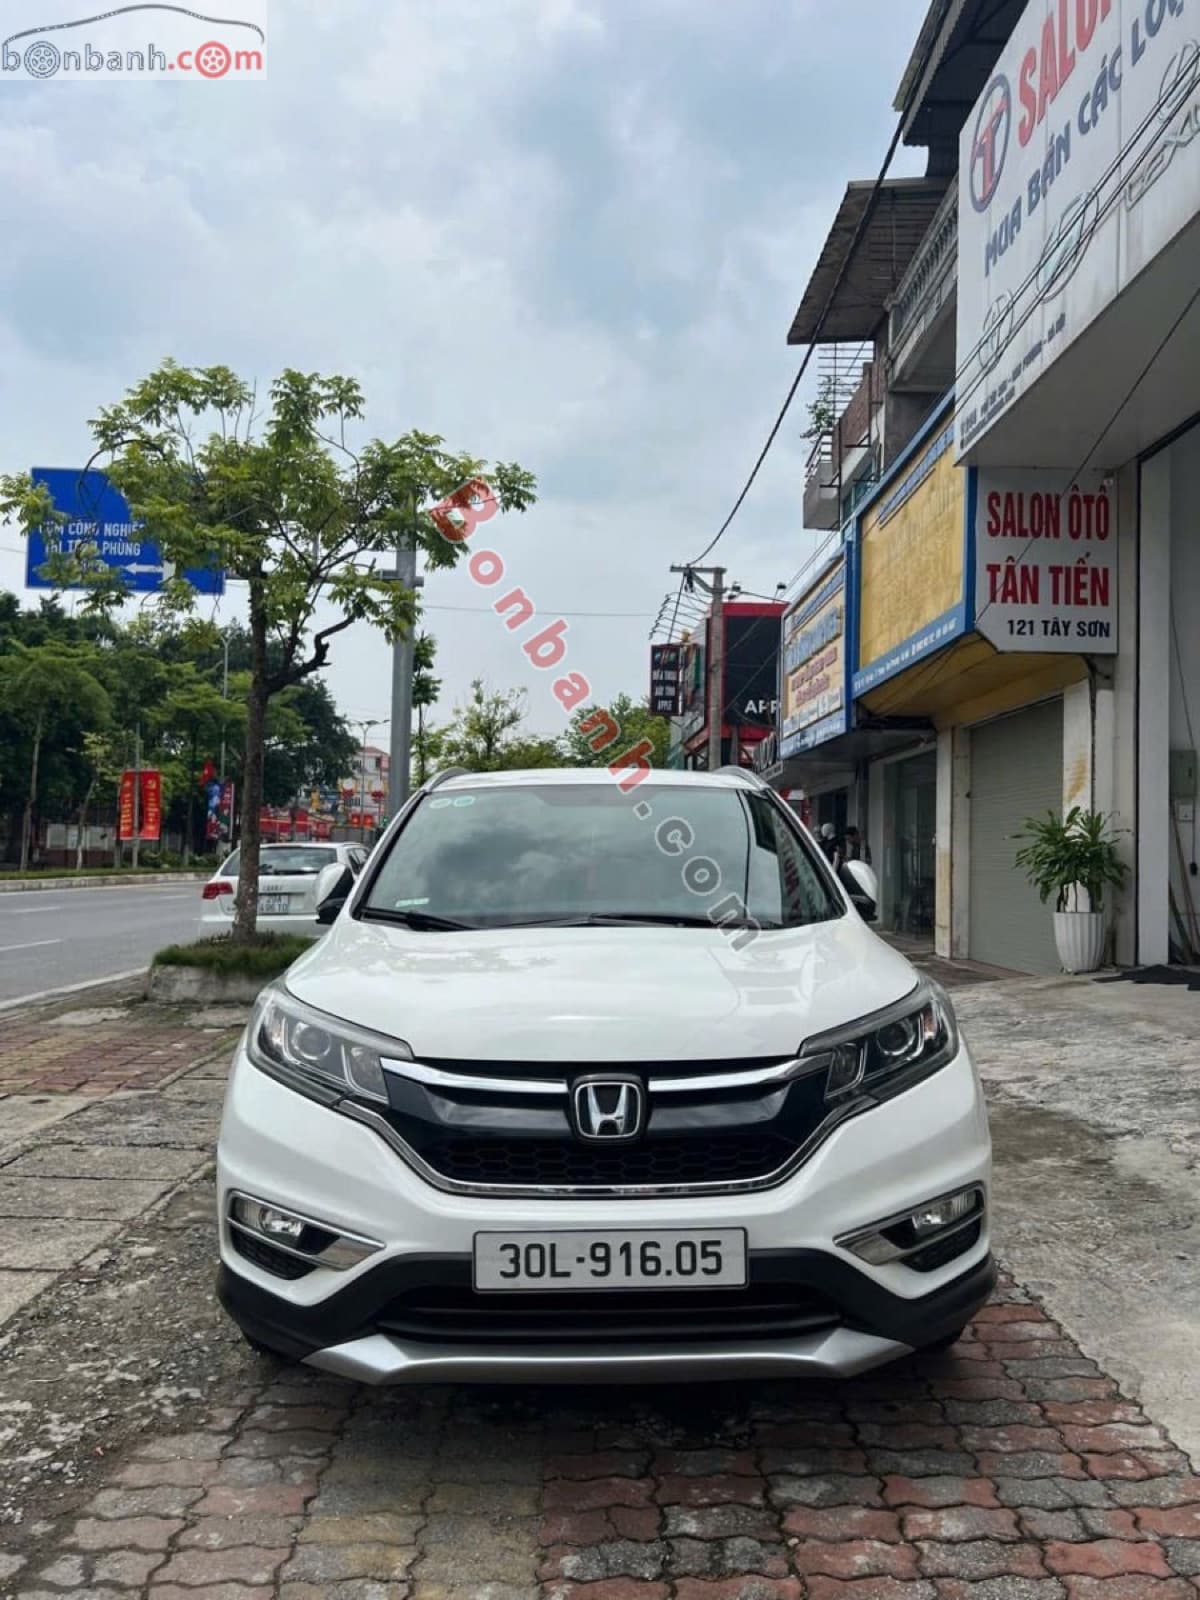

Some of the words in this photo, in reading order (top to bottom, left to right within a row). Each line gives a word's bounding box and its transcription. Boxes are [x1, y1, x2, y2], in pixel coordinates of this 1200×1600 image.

[1018, 0, 1111, 148] SALO
[985, 195, 1022, 277] MUA
[1027, 120, 1070, 216] BÁN
[1078, 43, 1122, 135] CÁC
[987, 491, 1061, 540] SALON
[1068, 484, 1110, 541] ÔTÔ
[102, 537, 141, 557] PHÙNG
[986, 555, 1040, 605] TÂN
[1048, 551, 1110, 607] TIẾN
[1008, 619, 1034, 636] 121
[1042, 616, 1072, 637] TÂY
[1076, 620, 1111, 639] SƠN
[499, 1240, 723, 1279] 30L-916.05
